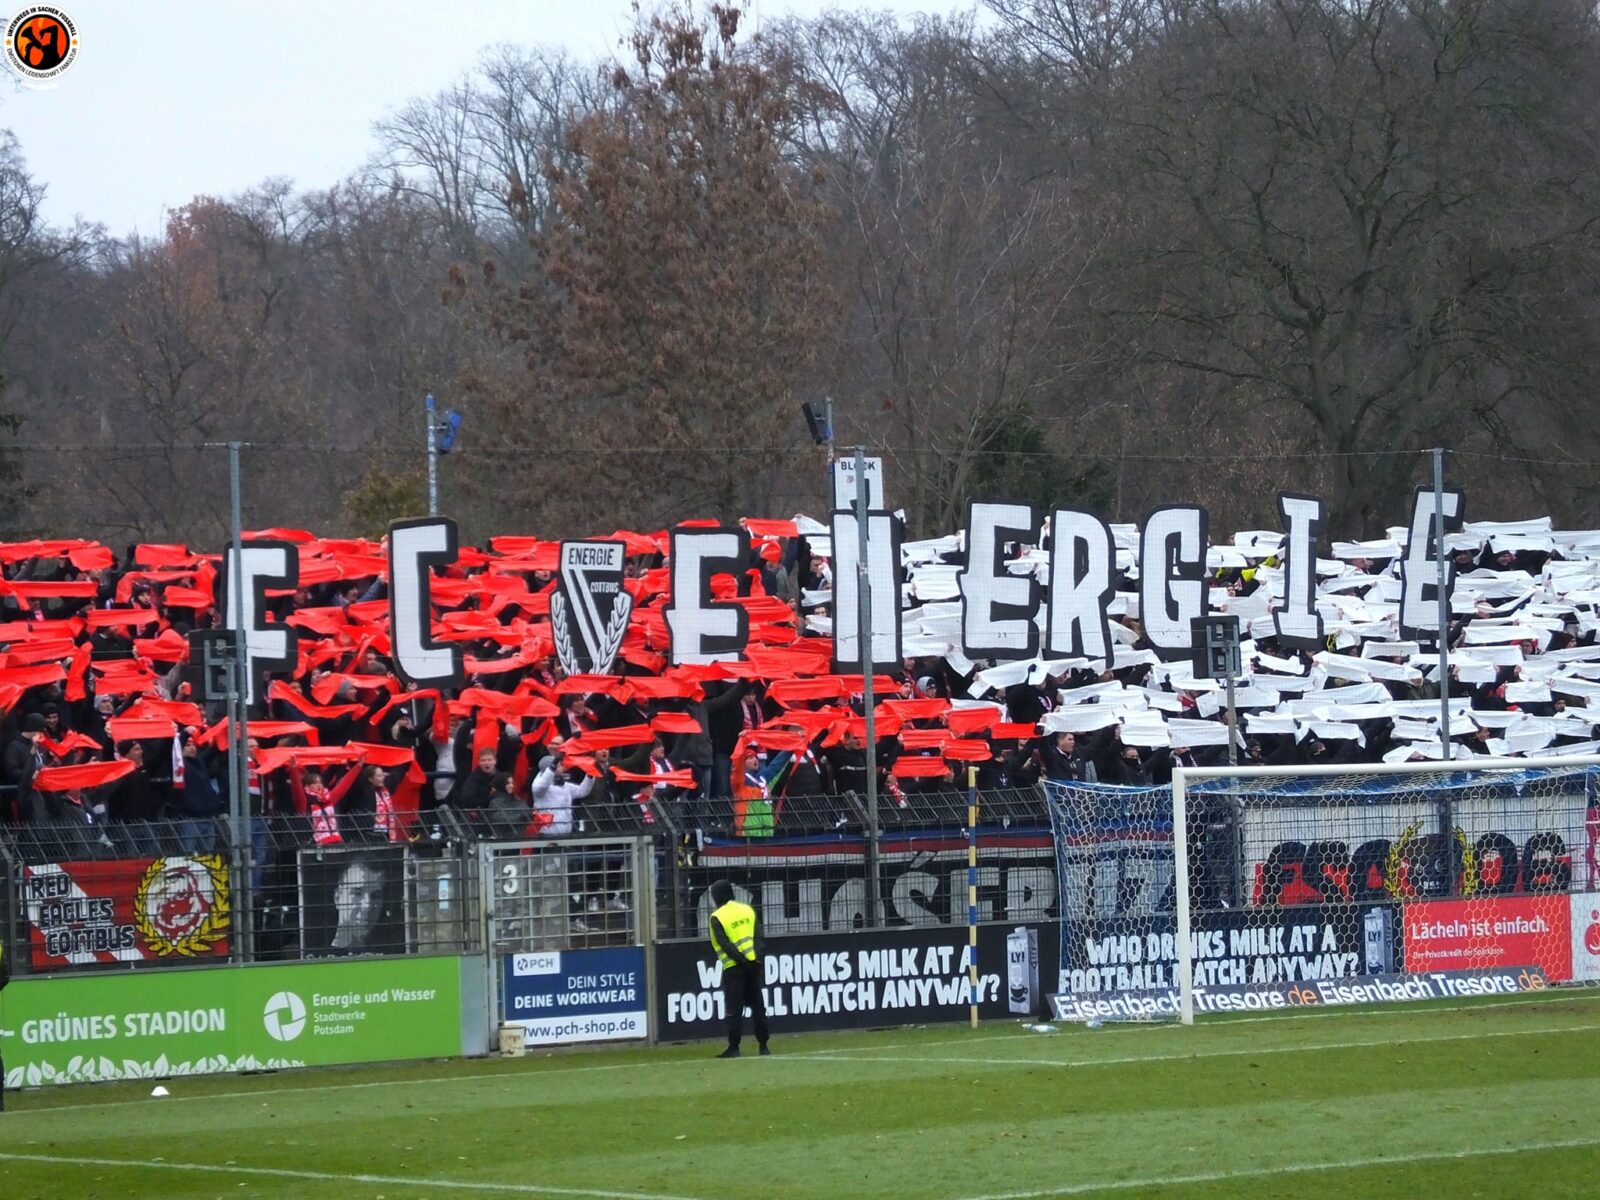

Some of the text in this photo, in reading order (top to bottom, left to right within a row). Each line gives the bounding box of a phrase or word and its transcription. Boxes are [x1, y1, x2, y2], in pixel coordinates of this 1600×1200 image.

[840, 461, 876, 471] BLCK
[568, 547, 615, 566] ENERGIE
[590, 581, 620, 594] COTTBUS
[30, 873, 71, 900] RED
[502, 864, 518, 894] 3
[39, 898, 113, 929] EAGLES
[1412, 915, 1550, 939] Lächeln ist einfach.
[45, 925, 135, 956] COTTBUS
[1085, 936, 1142, 965] WHO
[1230, 927, 1285, 956] MILK
[1289, 925, 1316, 952] AT
[1321, 924, 1337, 951] A
[530, 958, 554, 969] PCH
[1425, 948, 1462, 958] Privatkredit
[764, 951, 851, 985] DRINKS
[858, 948, 918, 979] MILK
[923, 946, 954, 975] AT
[1059, 964, 1168, 994] FOOTBALL
[1252, 952, 1359, 984] ANYWAY?
[567, 972, 636, 989] DEIN STYLE
[312, 988, 436, 1008] Energie und Wasser
[514, 989, 636, 1009] DEINE WORKWEAR
[667, 974, 1000, 1023] FOOTLL MATCH ANYWAY?
[1054, 969, 1546, 1019] Eisenbach Tresore.de Eisenbach Tresore.de
[21, 1008, 225, 1044] GRÜNES STADION
[313, 1010, 366, 1022] Stadtwerke
[314, 1025, 354, 1035] Potsdam
